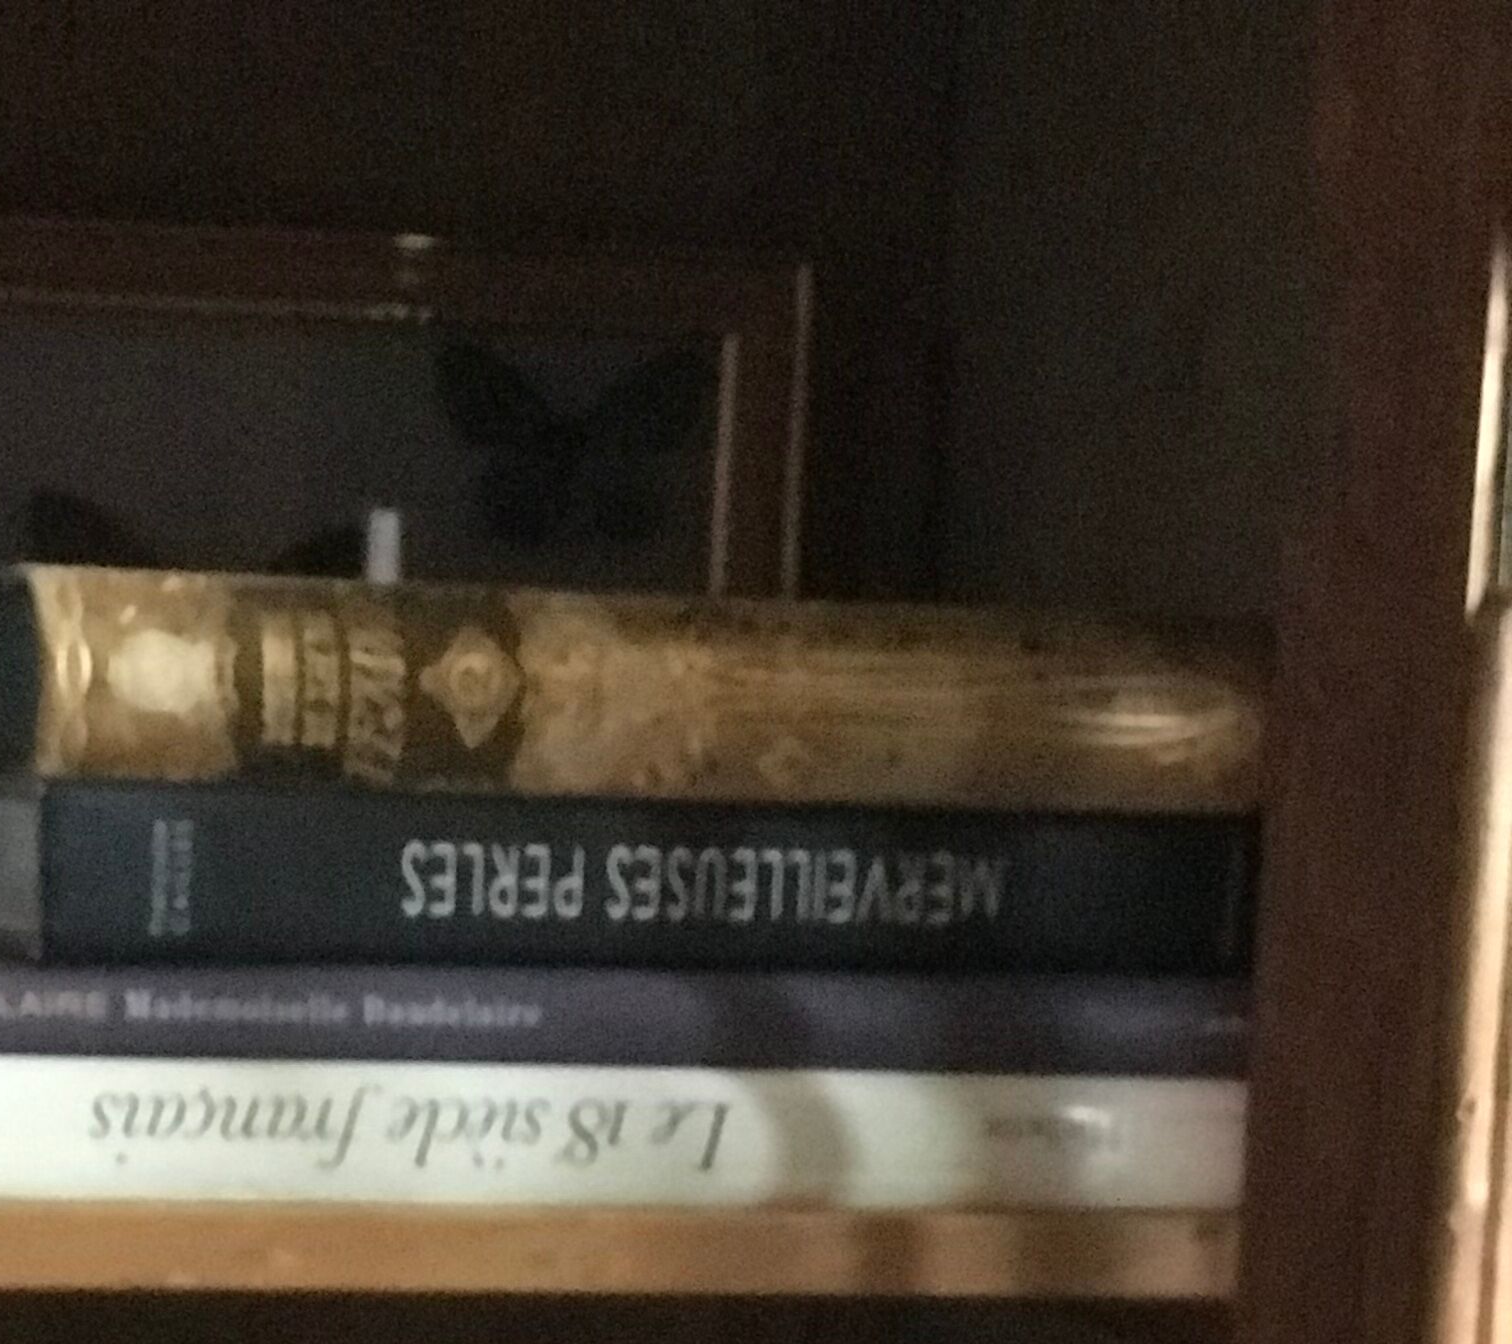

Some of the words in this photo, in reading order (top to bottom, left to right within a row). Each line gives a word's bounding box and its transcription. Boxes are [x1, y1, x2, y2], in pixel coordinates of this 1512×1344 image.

[400, 837, 585, 918] PERLES
[605, 839, 1006, 924] MERVEILLEUSES
[124, 988, 351, 1023] Mademoiselle
[363, 992, 542, 1028] Baudelaire
[88, 1085, 377, 1171] français
[388, 1095, 549, 1169] siècle
[648, 1101, 730, 1174] Le
